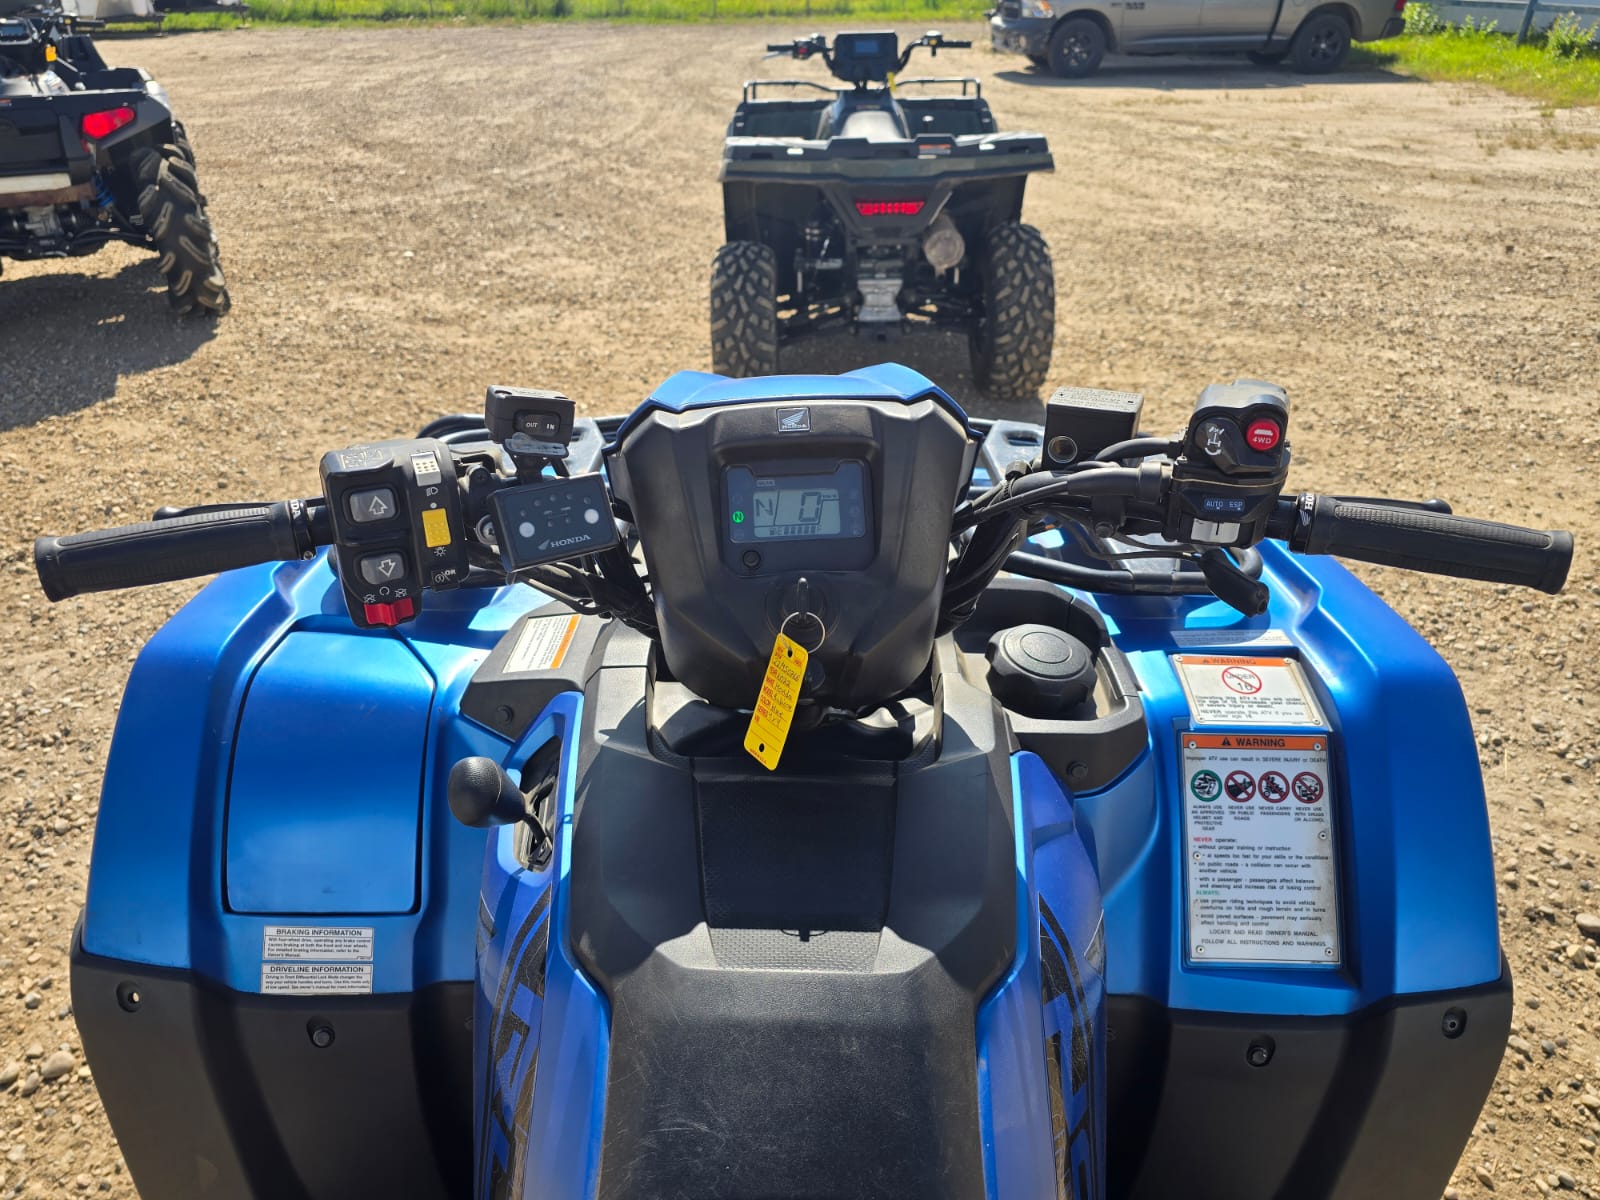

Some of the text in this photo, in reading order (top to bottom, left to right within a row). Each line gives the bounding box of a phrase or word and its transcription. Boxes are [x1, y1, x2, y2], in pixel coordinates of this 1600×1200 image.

[756, 492, 821, 522] N 0
[551, 535, 591, 547] HONDA
[1236, 738, 1285, 747] WARNING
